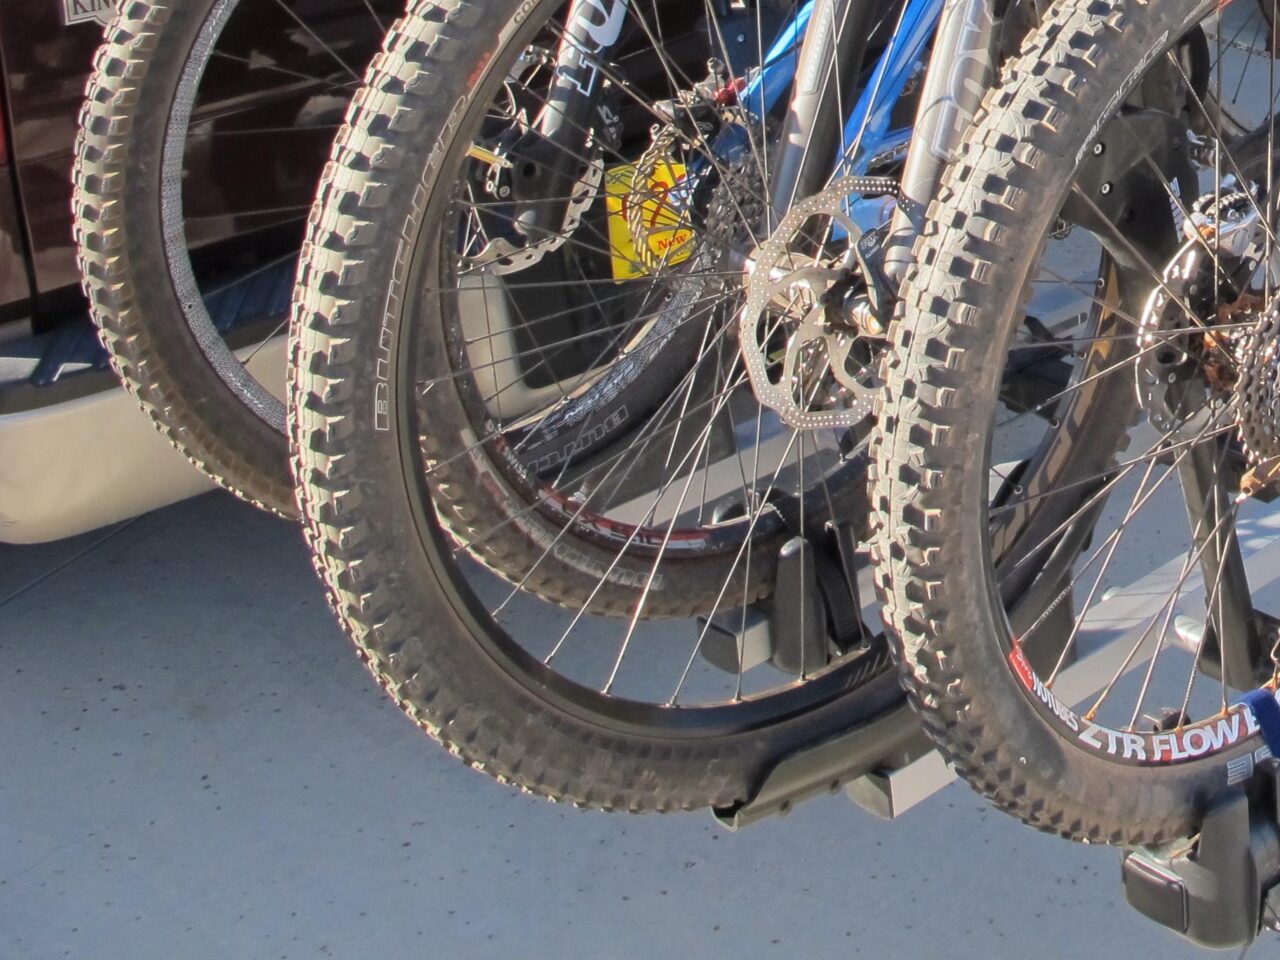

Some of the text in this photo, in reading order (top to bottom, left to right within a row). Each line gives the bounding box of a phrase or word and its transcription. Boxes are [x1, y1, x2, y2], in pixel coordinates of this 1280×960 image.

[374, 95, 467, 431] BUTCHER
[1032, 672, 1079, 732] NOTUBES
[1078, 716, 1147, 761] ZTR
[1152, 714, 1242, 762] FLOW
